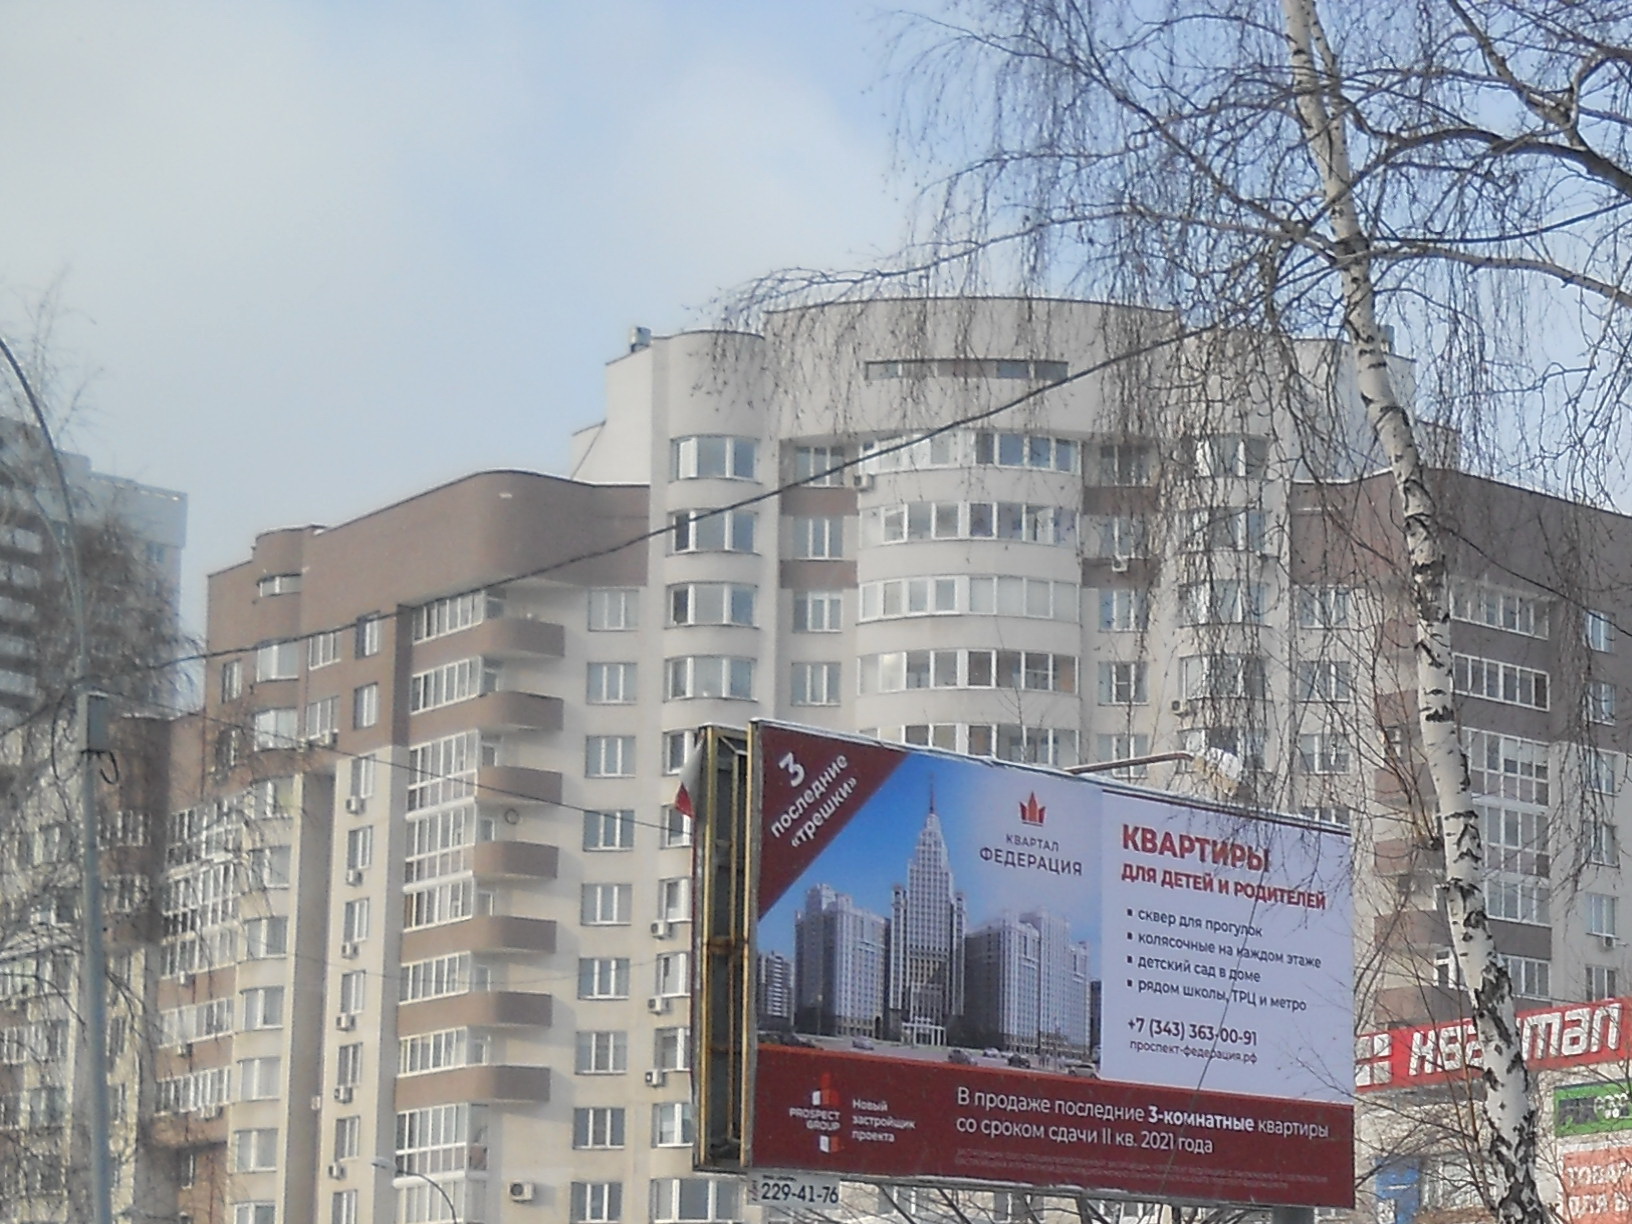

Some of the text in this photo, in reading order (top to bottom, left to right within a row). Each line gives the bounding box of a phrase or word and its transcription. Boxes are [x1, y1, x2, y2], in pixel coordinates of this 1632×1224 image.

[778, 752, 806, 787] 3
[770, 755, 848, 838] последние
[791, 777, 857, 848] «трешки»
[1006, 833, 1059, 852] КВАРТАЛ
[1122, 824, 1269, 873] КВАРТИРЫ
[980, 847, 1082, 876] ФЕДЕРАЦИЯ
[1121, 863, 1326, 910] ДЛЯ ДЕТЕЙ И РОДИТЕЛЕЙ
[1138, 909, 1262, 938] сквер для прогулок
[1138, 933, 1321, 968] колясочные на каждом этаже
[1138, 955, 1261, 983] детский сад в доме
[1138, 979, 1179, 995] рядом
[1232, 990, 1256, 1006] ТРЦ
[1259, 995, 1267, 1006] и
[1270, 997, 1307, 1012] метро
[1128, 1017, 1257, 1046] +7 (343) 363-00-91
[1130, 1039, 1257, 1064] проспект-федерация.рф
[789, 1107, 840, 1121] PROSPECT
[852, 1099, 888, 1112] Новый
[957, 1087, 1329, 1139] В продаже последние 3-комнатные квартиры
[806, 1120, 840, 1131] GROUP
[851, 1130, 895, 1143] проекта
[852, 1115, 916, 1129] застройщик
[957, 1117, 977, 1133] со
[981, 1119, 1045, 1138] сроком
[1049, 1126, 1098, 1144] сдачи
[1115, 1133, 1138, 1148] кв.
[1141, 1130, 1174, 1149] 2021
[1178, 1137, 1214, 1155] года
[761, 1182, 839, 1204] 229-41-76
